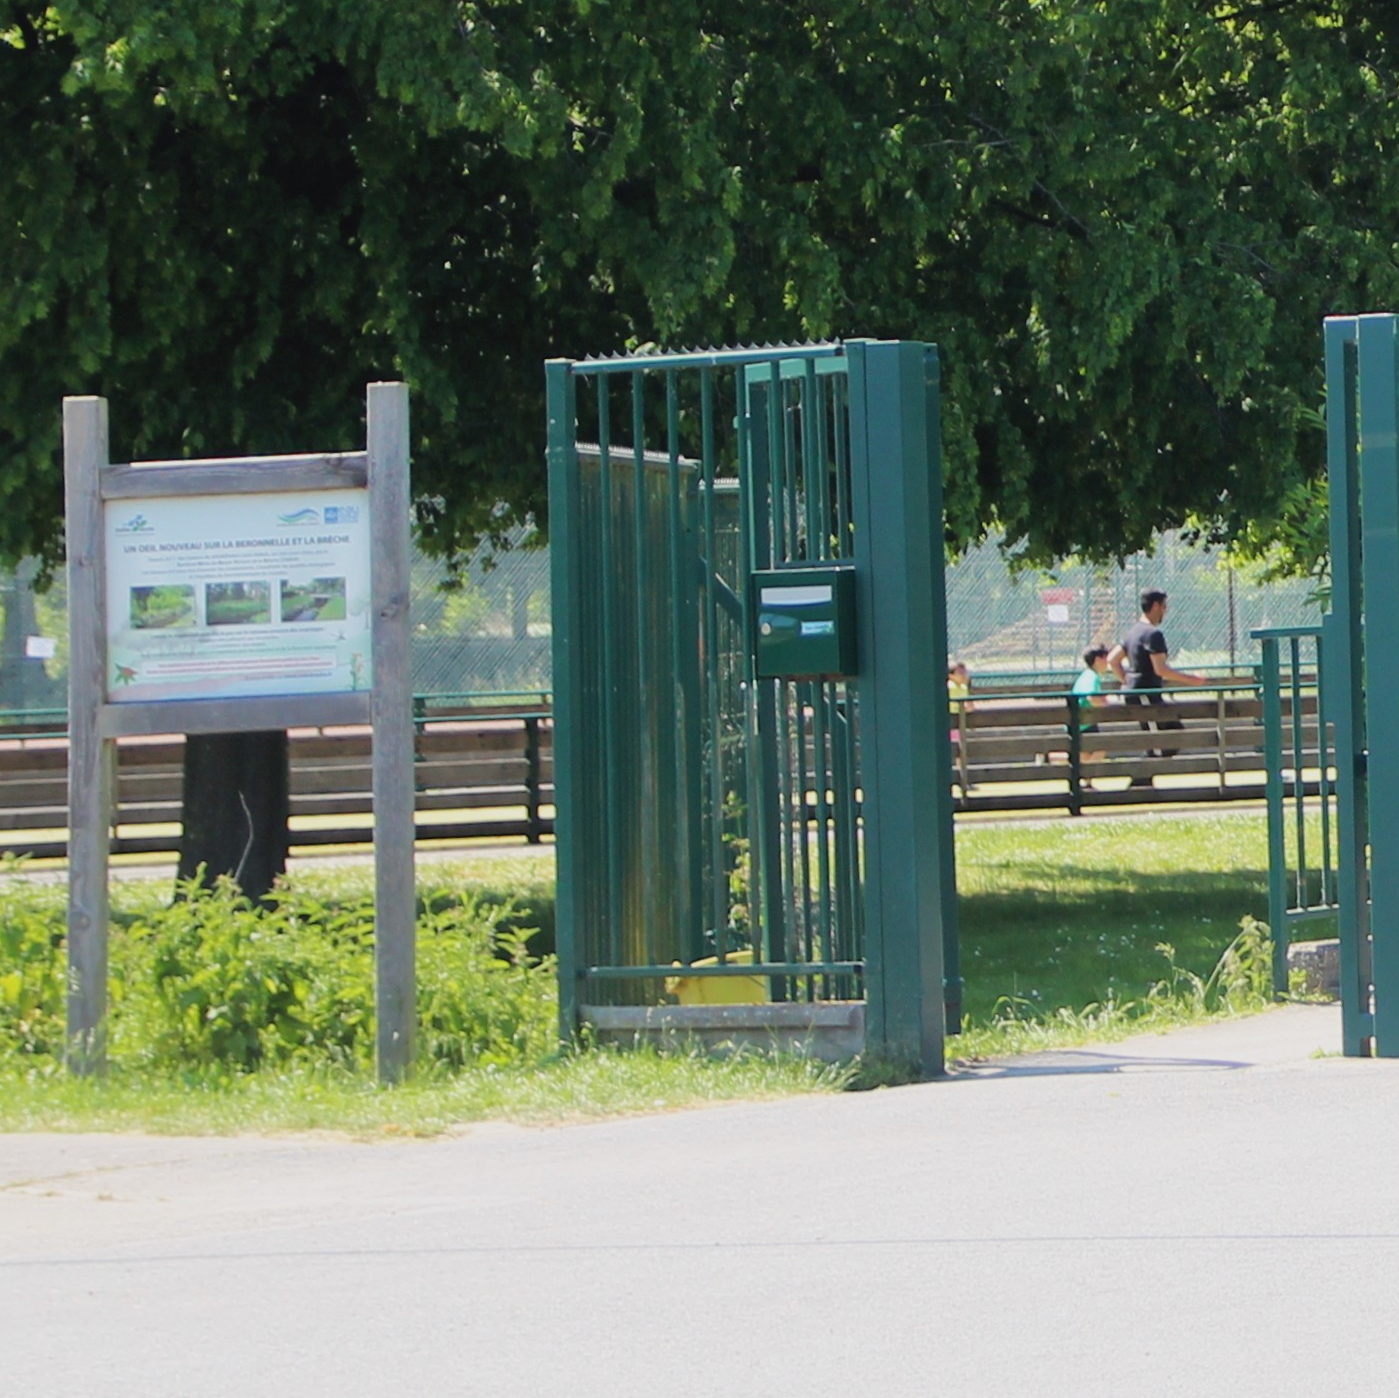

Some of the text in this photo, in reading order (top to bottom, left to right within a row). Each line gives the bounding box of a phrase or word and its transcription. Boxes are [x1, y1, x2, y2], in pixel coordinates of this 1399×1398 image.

[123, 545, 137, 554] UN
[138, 544, 158, 553] OEIL
[159, 542, 202, 552] NOUVEAU
[203, 541, 221, 550] SUR
[222, 540, 233, 549] LA
[235, 538, 290, 549] BERONNELLE
[292, 537, 303, 545] ET
[304, 536, 315, 544] LA
